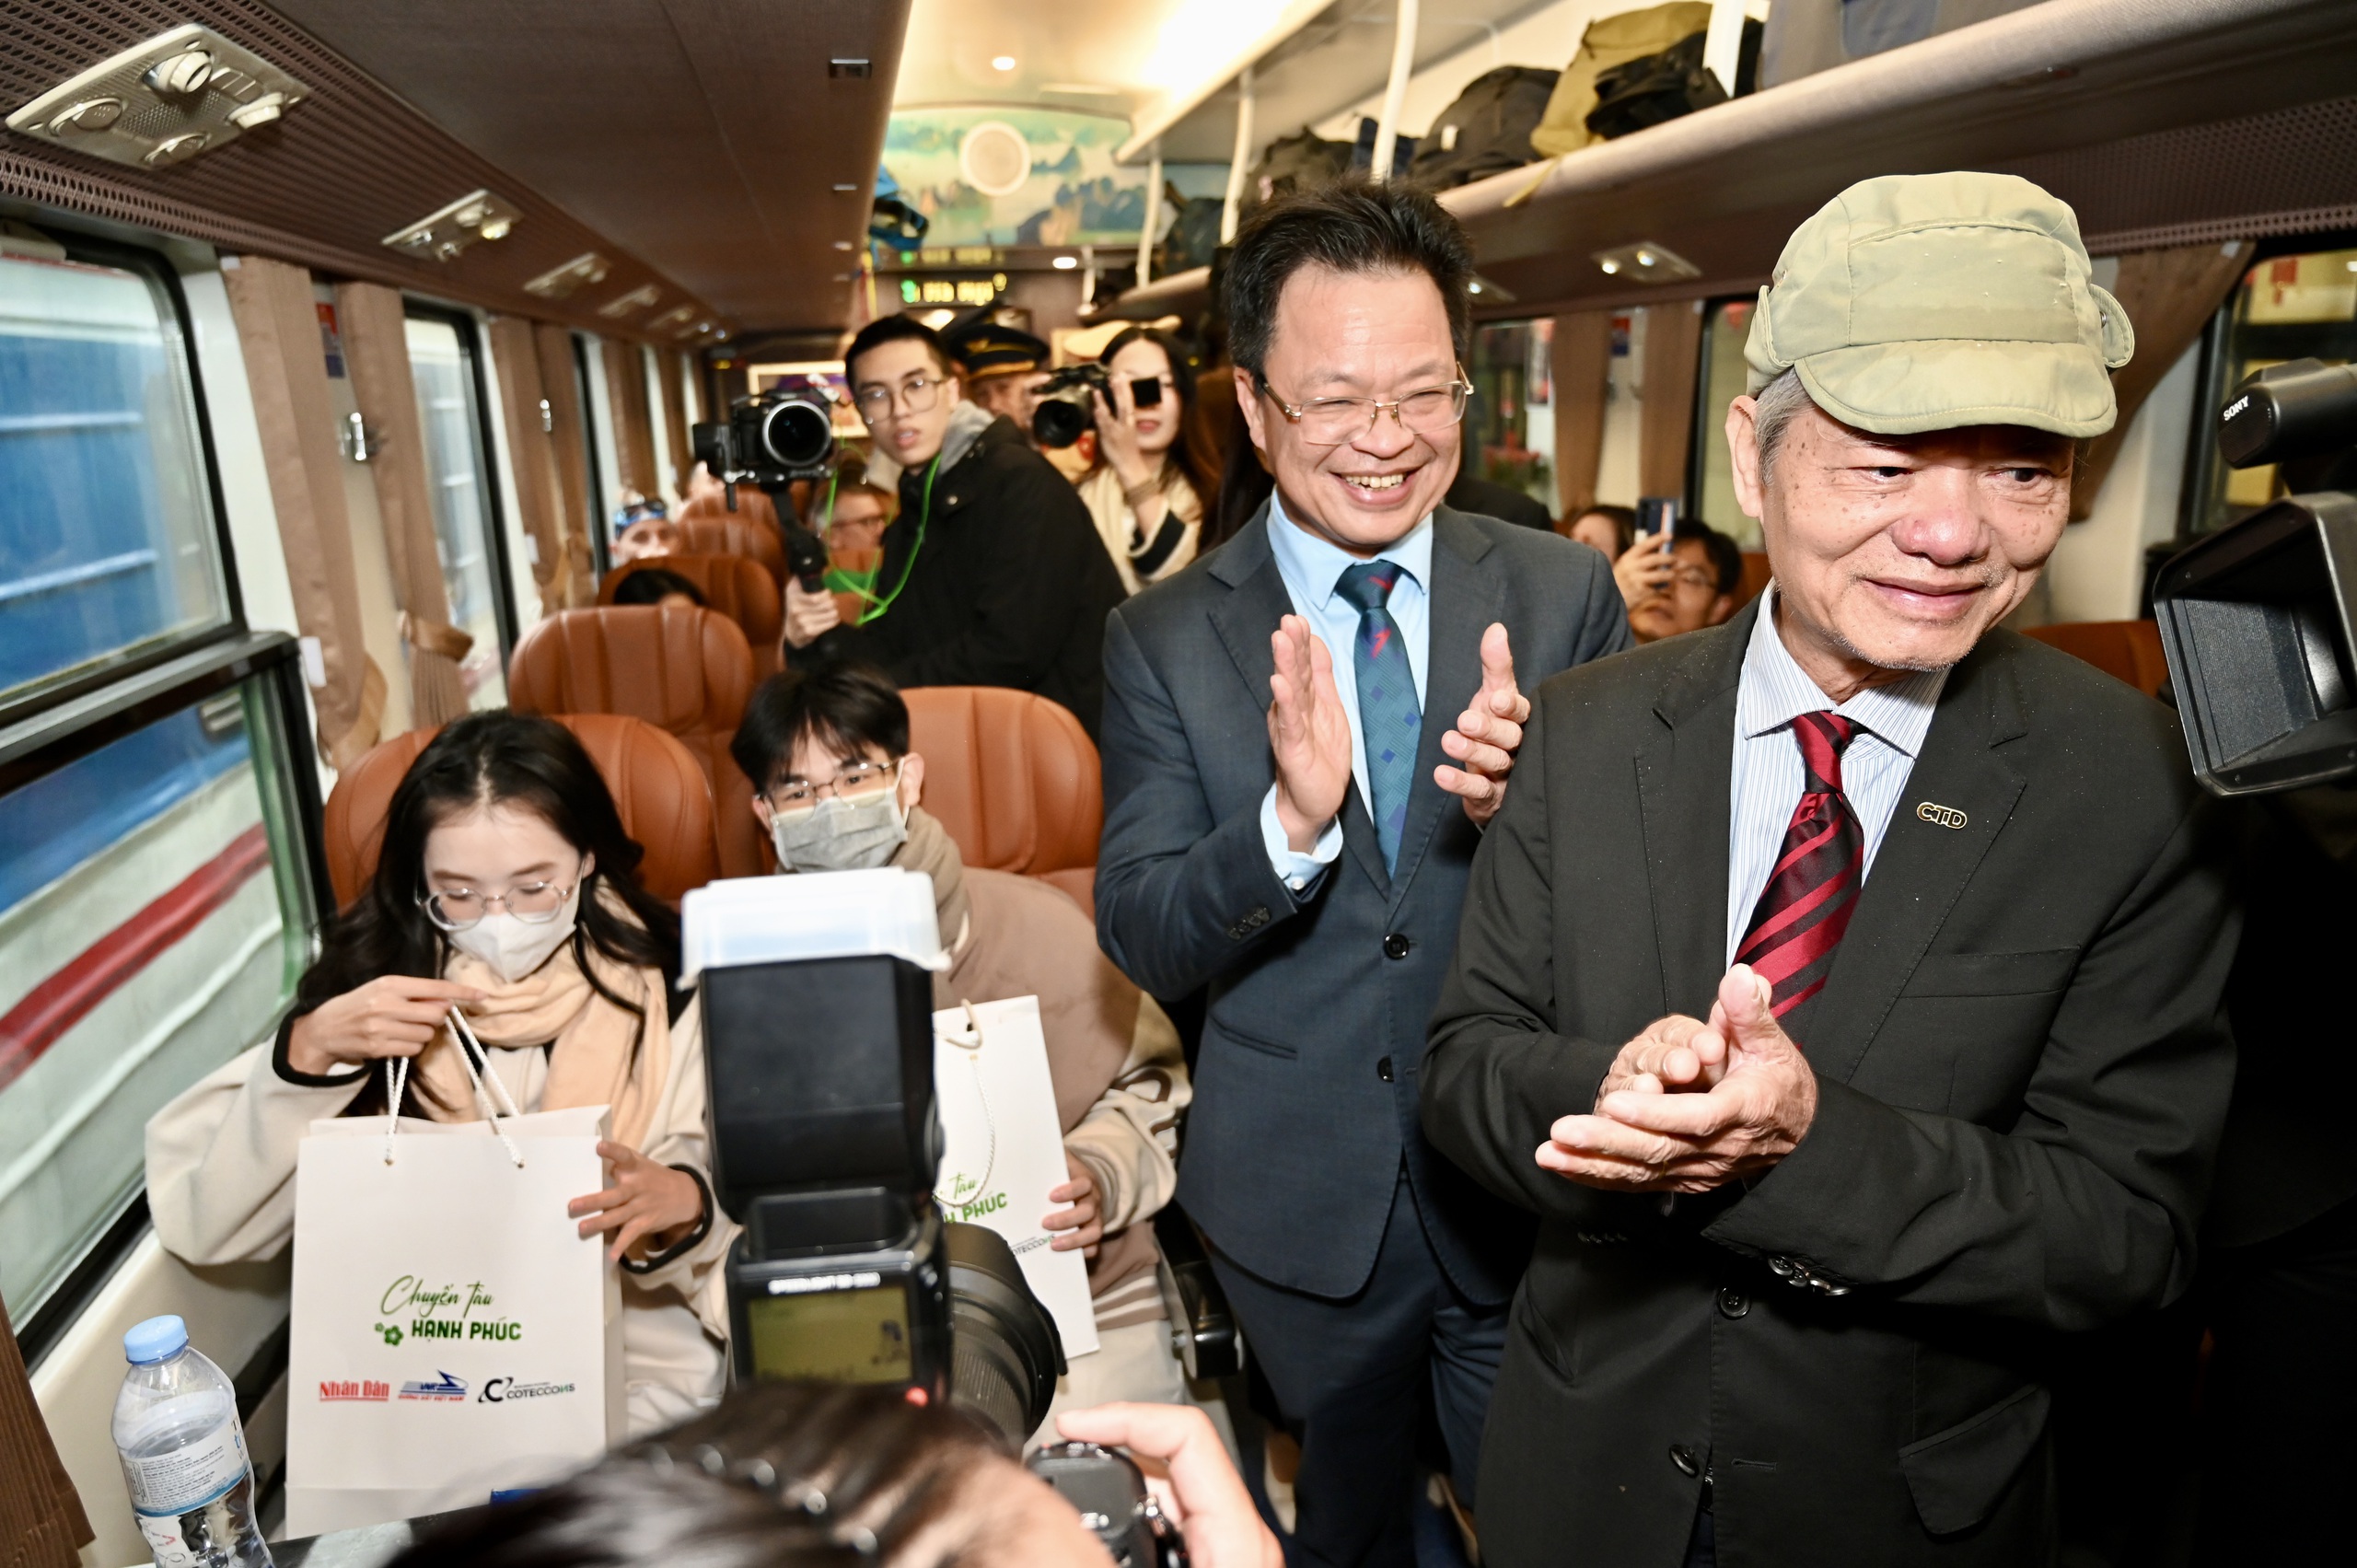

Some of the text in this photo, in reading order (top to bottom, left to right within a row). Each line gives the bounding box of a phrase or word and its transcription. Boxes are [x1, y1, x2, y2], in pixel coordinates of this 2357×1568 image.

[2223, 395, 2249, 422] SONY
[1916, 801, 1968, 830] CTD
[381, 1274, 460, 1318] Chuyến
[412, 1317, 522, 1342] HẠNH PHÚC
[319, 1379, 360, 1398] Nhân
[363, 1379, 390, 1398] Dân
